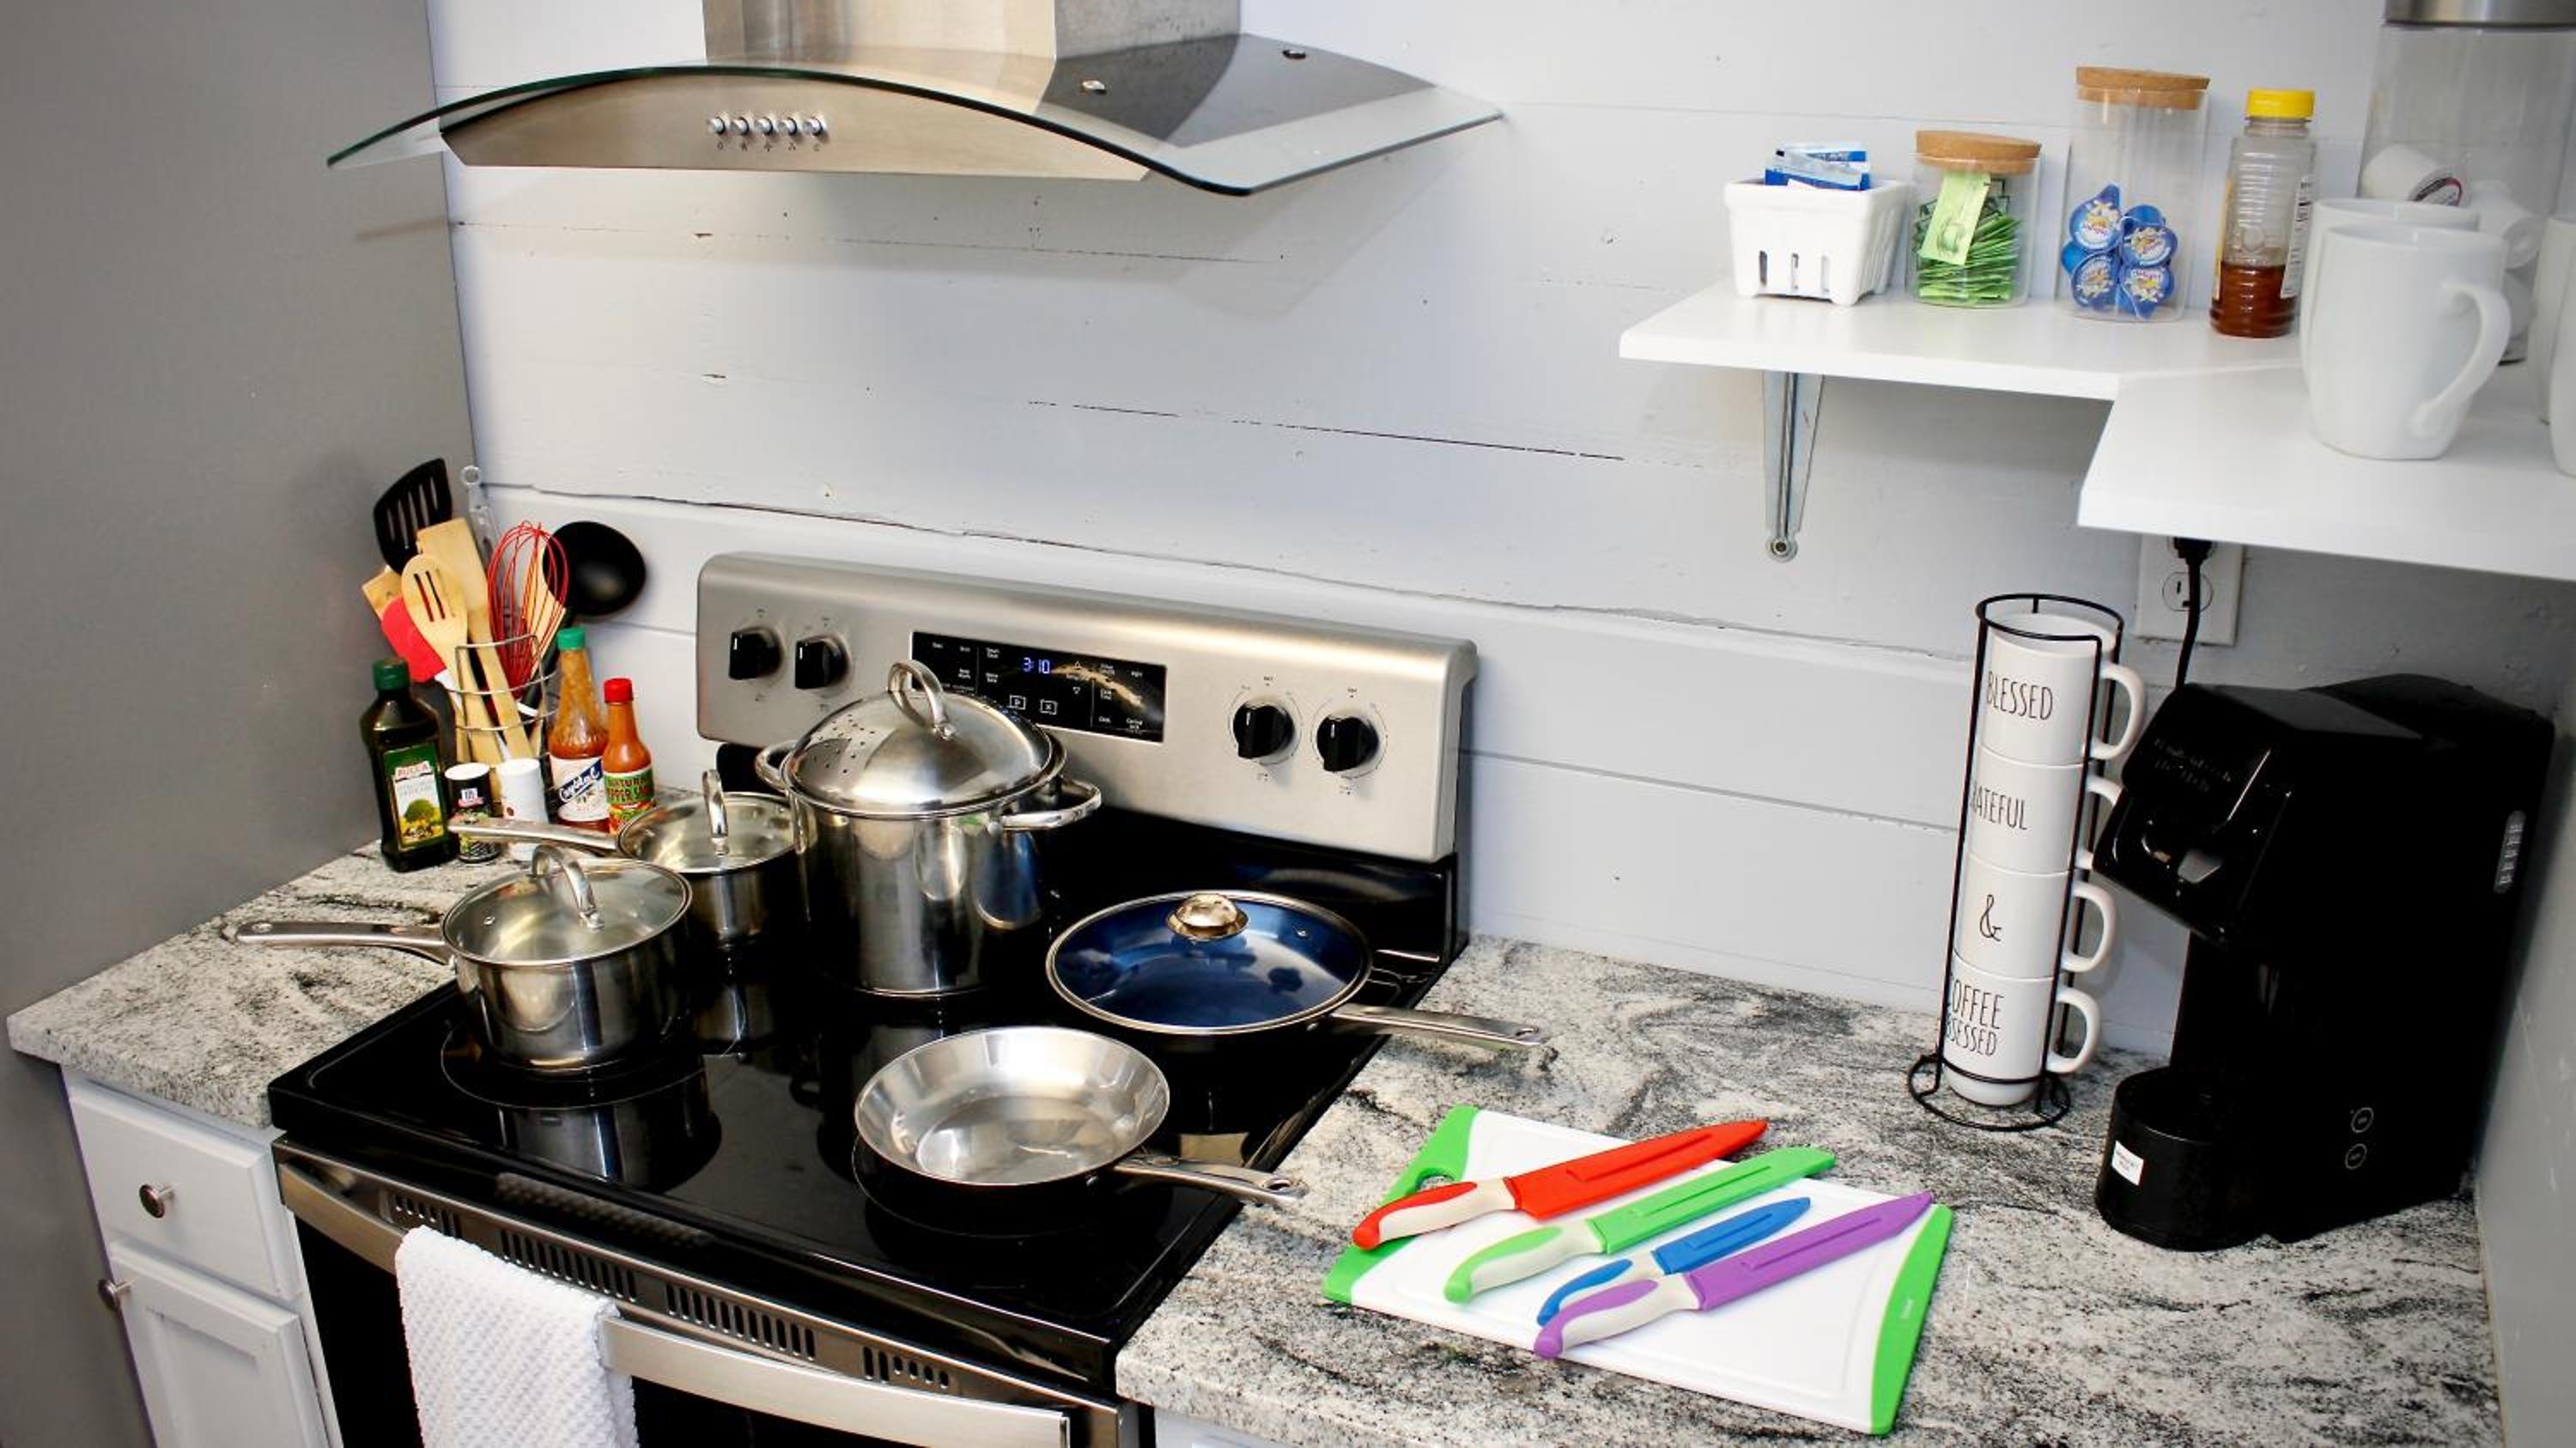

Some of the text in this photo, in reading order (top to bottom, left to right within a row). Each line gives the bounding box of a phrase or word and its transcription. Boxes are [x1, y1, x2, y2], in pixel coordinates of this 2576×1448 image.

[1023, 657, 1050, 674] 3:10
[1986, 670, 2054, 720] BLESSED
[1971, 781, 2028, 830] RATEFUL
[1978, 893, 2002, 942] &
[1949, 972, 2005, 1030] OFFEE
